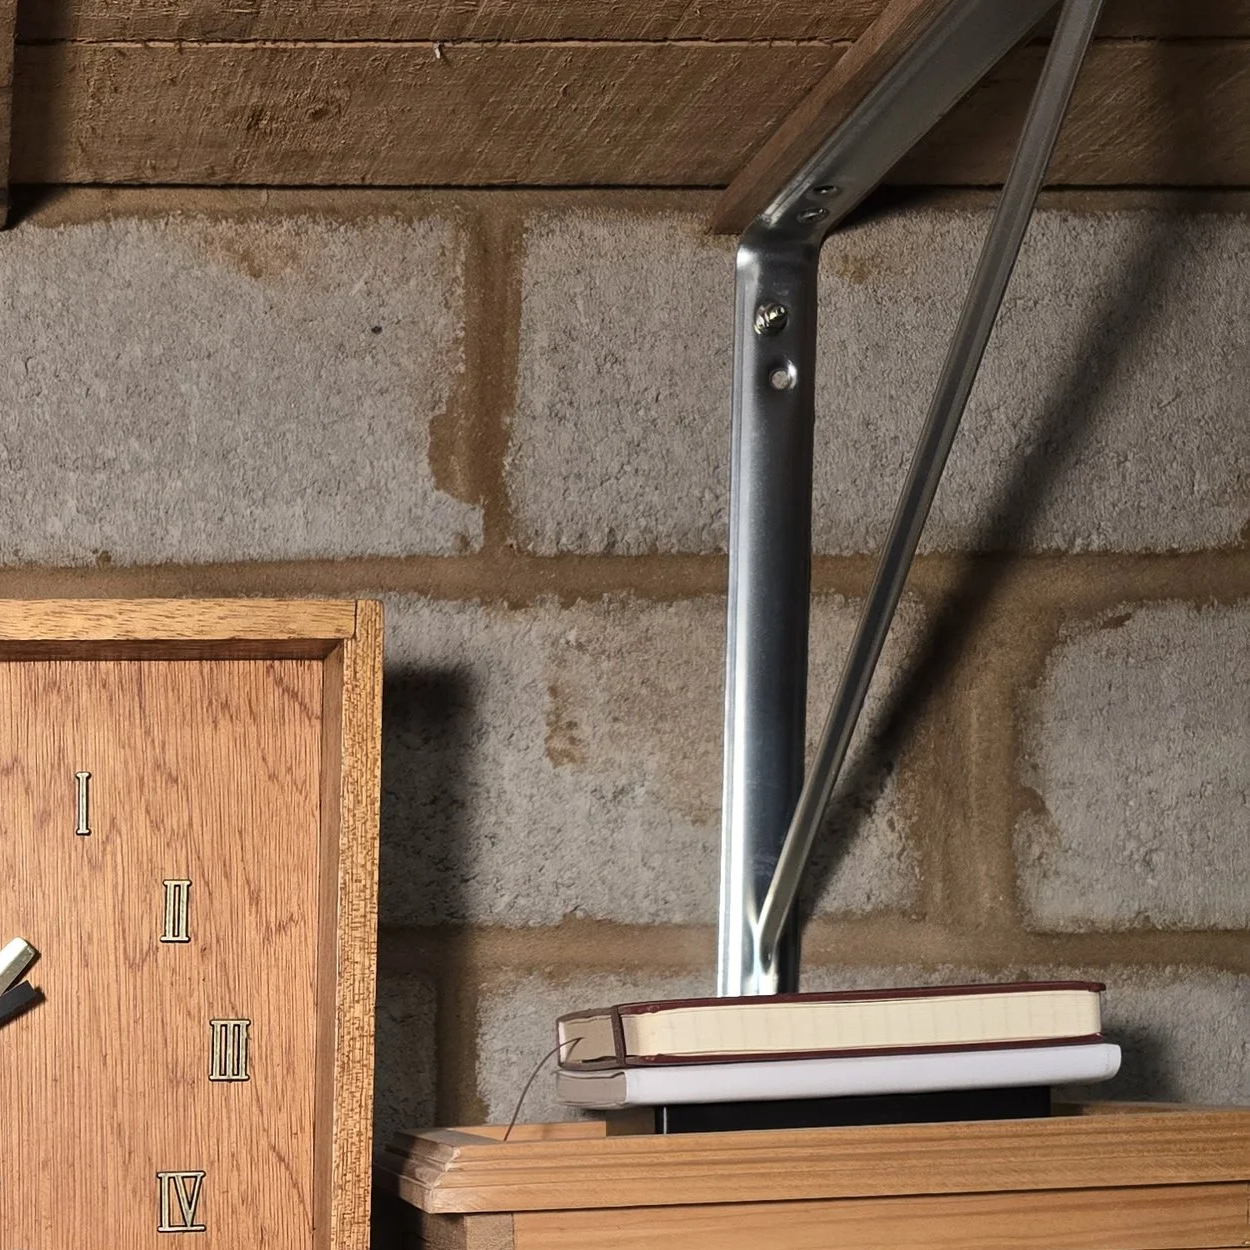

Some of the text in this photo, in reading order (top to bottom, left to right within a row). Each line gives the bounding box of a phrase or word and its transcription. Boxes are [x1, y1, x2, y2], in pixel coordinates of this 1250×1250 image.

[75, 771, 93, 837] I
[160, 878, 193, 945] II
[208, 1018, 251, 1083] III
[155, 1170, 208, 1234] IV
